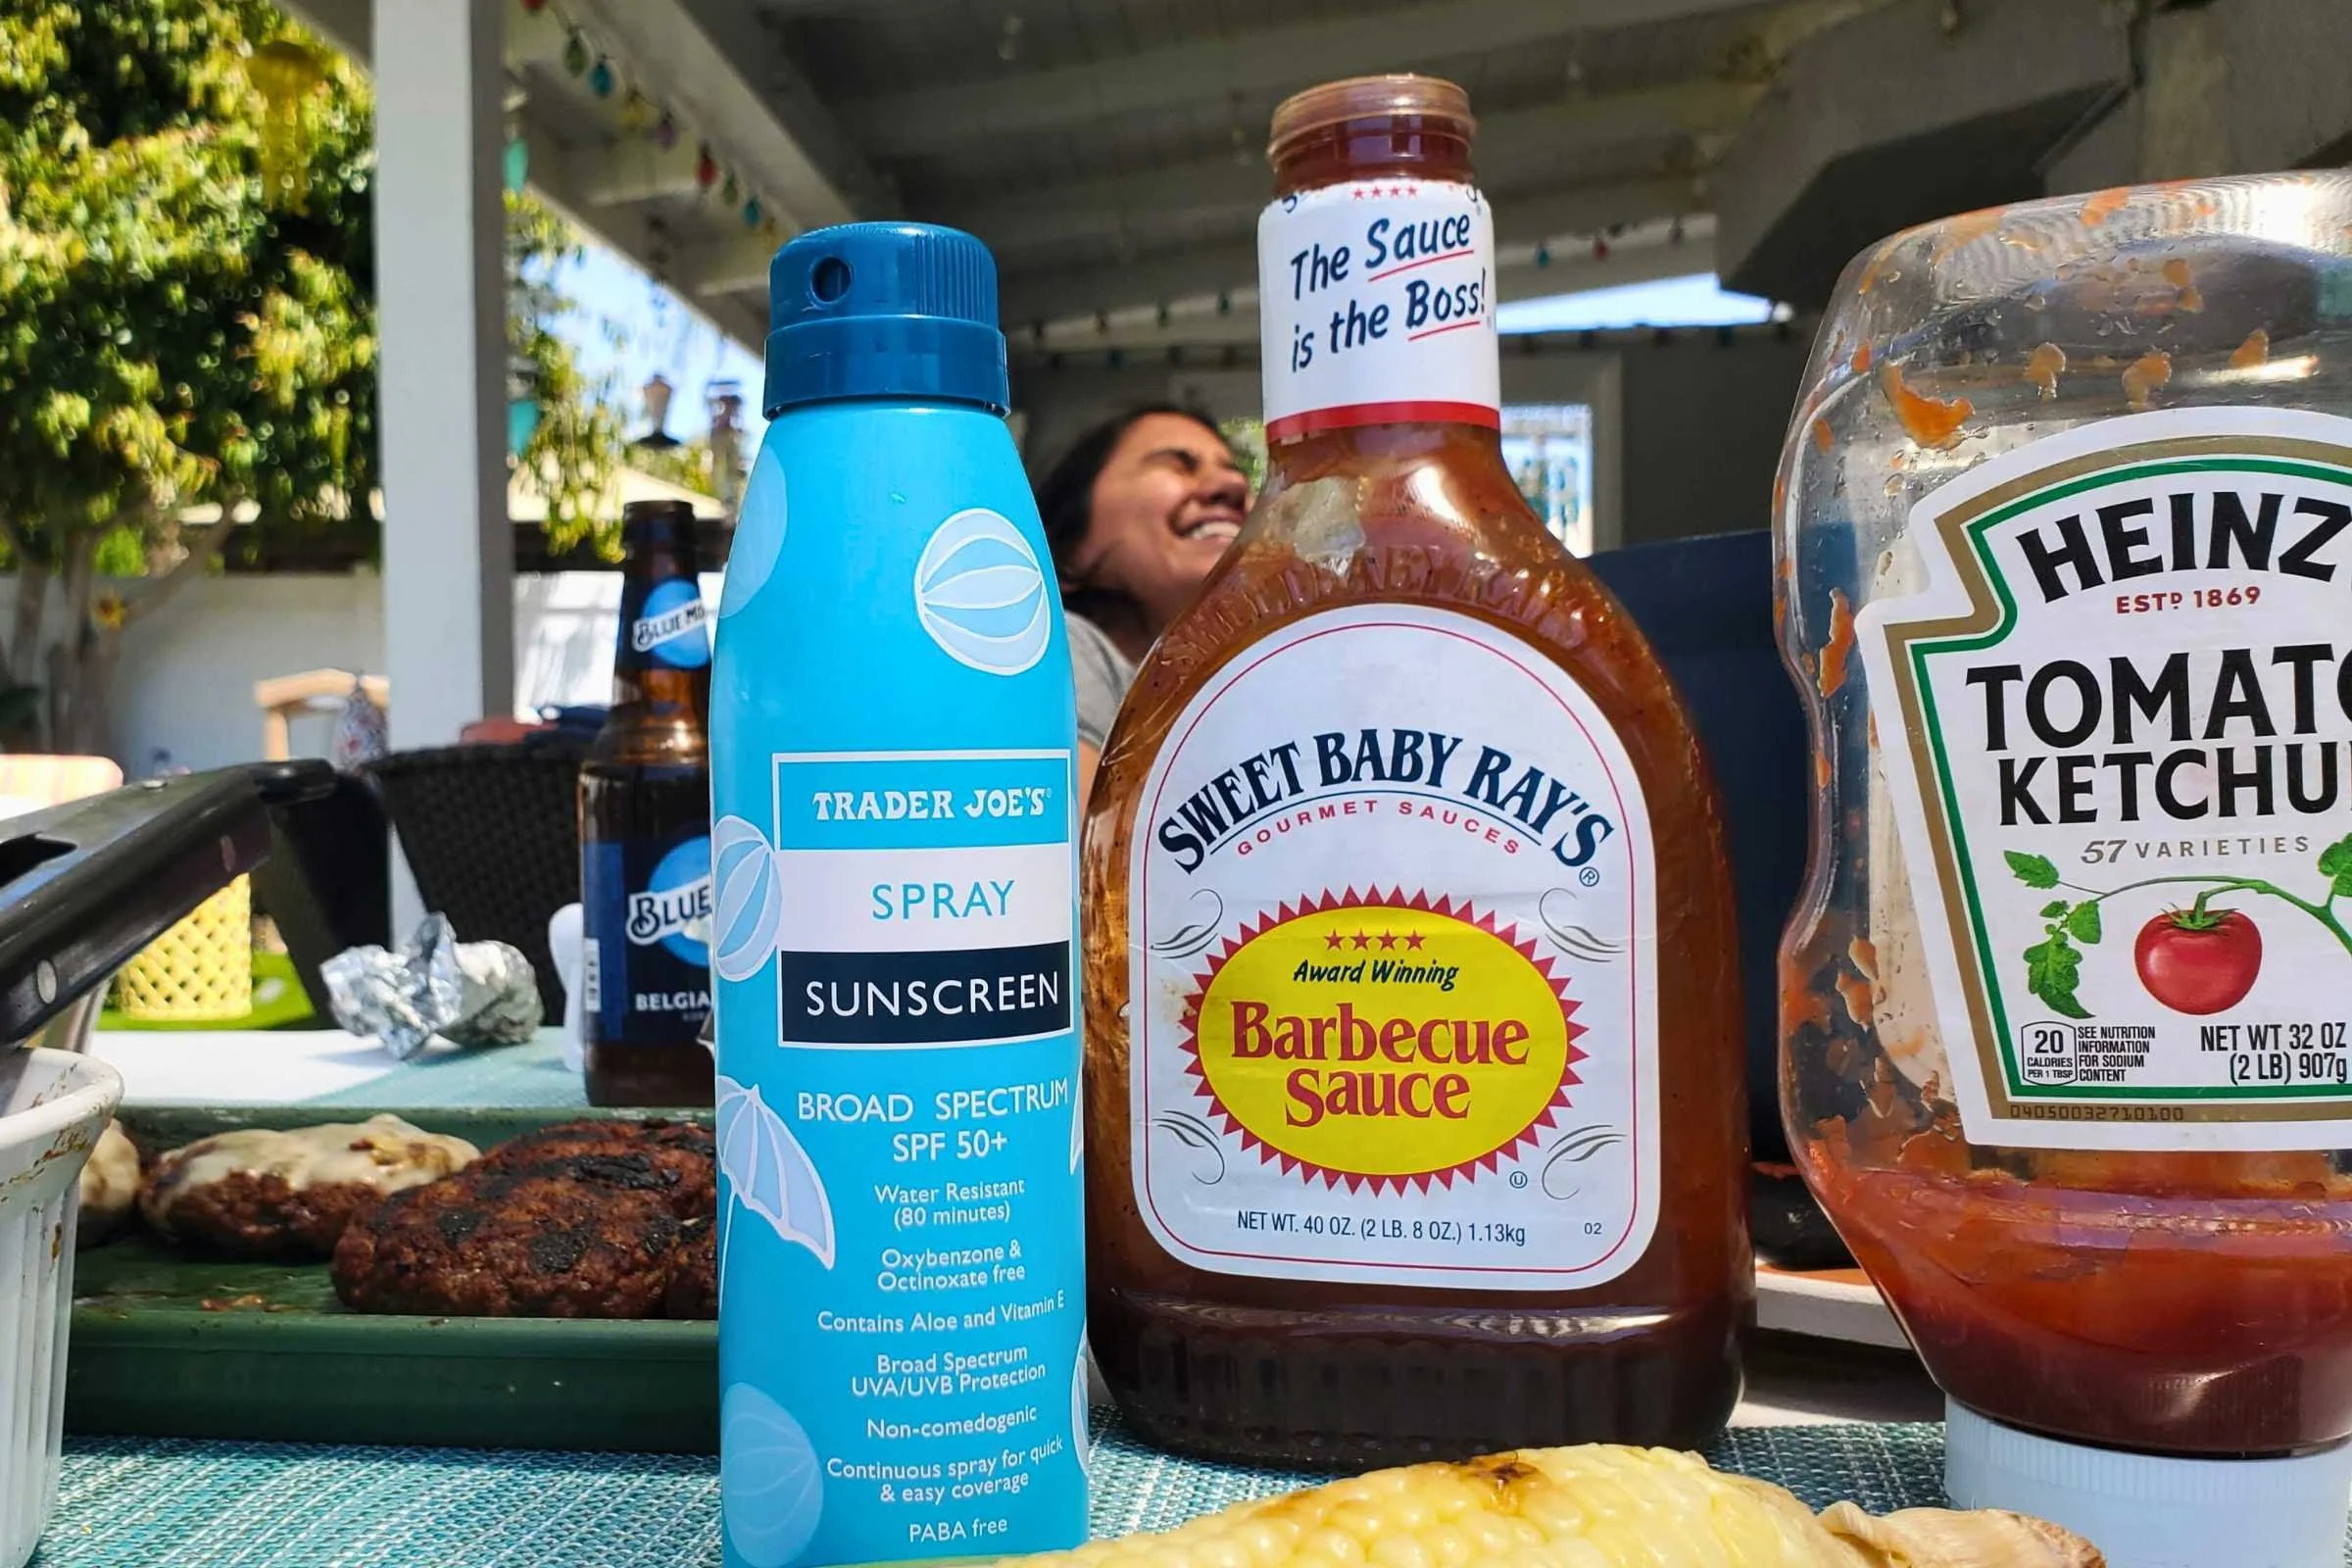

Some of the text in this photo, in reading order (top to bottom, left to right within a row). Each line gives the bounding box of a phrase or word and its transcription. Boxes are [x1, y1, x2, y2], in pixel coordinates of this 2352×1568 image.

[1291, 214, 1471, 301] The Sauce
[1292, 267, 1487, 373] is the Boss!
[2014, 491, 2352, 604] HEINZ
[2193, 586, 2261, 608] 1869
[1965, 644, 2352, 751] TOMAT
[1998, 741, 2352, 826] KETCHU
[812, 791, 955, 819] TRADER
[1158, 728, 1615, 876] SWEET BABY RAY'S
[1238, 799, 1520, 857] GOURMET SAUCES
[2081, 836, 2309, 863] 57 VARIETIES
[631, 885, 710, 938] BLUE
[872, 880, 1015, 919] SPRAY
[1294, 958, 1459, 992] Award Winning
[635, 991, 711, 1011] BELGIA
[807, 972, 1058, 1016] SUNSCREEN
[1231, 1001, 1531, 1065] Barbecue
[2034, 1030, 2064, 1054] 20
[2078, 1026, 2155, 1039] SEE NUTRITION
[2078, 1041, 2150, 1054] INFORMATION
[2201, 1022, 2347, 1052] NET WT 32 OZ
[2027, 1057, 2073, 1068] CALORIES
[2028, 1069, 2043, 1078] PER
[2053, 1069, 2074, 1079] TBSP
[2079, 1054, 2144, 1067] FOR SODIUM
[2079, 1069, 2127, 1082] CONTENT
[2230, 1051, 2347, 1086] (2 LB) 907g
[798, 1078, 1068, 1122] BROAD SPECTRUM
[1285, 1068, 1471, 1129] Sauce
[893, 1129, 1007, 1162] SPF 50+
[874, 1179, 1025, 1203] Water Resistant
[894, 1202, 1010, 1231] (80 minutes)
[1237, 1210, 1525, 1247] NET WT. 40 OZ. (2 LB. 8 OZ.) 1.13kg
[1584, 1223, 1602, 1235] 02
[882, 1240, 1022, 1272] Oxybenzone &
[878, 1264, 1025, 1291] Octinoxate free
[817, 1290, 1065, 1333] Contains Aloe and Vitamin E
[878, 1347, 1027, 1376] Broad Spectrum
[852, 1363, 1046, 1396] UVA/UVB Protection
[867, 1405, 1037, 1439] Non-comedogenic
[827, 1435, 1063, 1481] Continuous spray for quick
[880, 1472, 1029, 1504] & easy coverage
[909, 1518, 1007, 1544] PABA free
